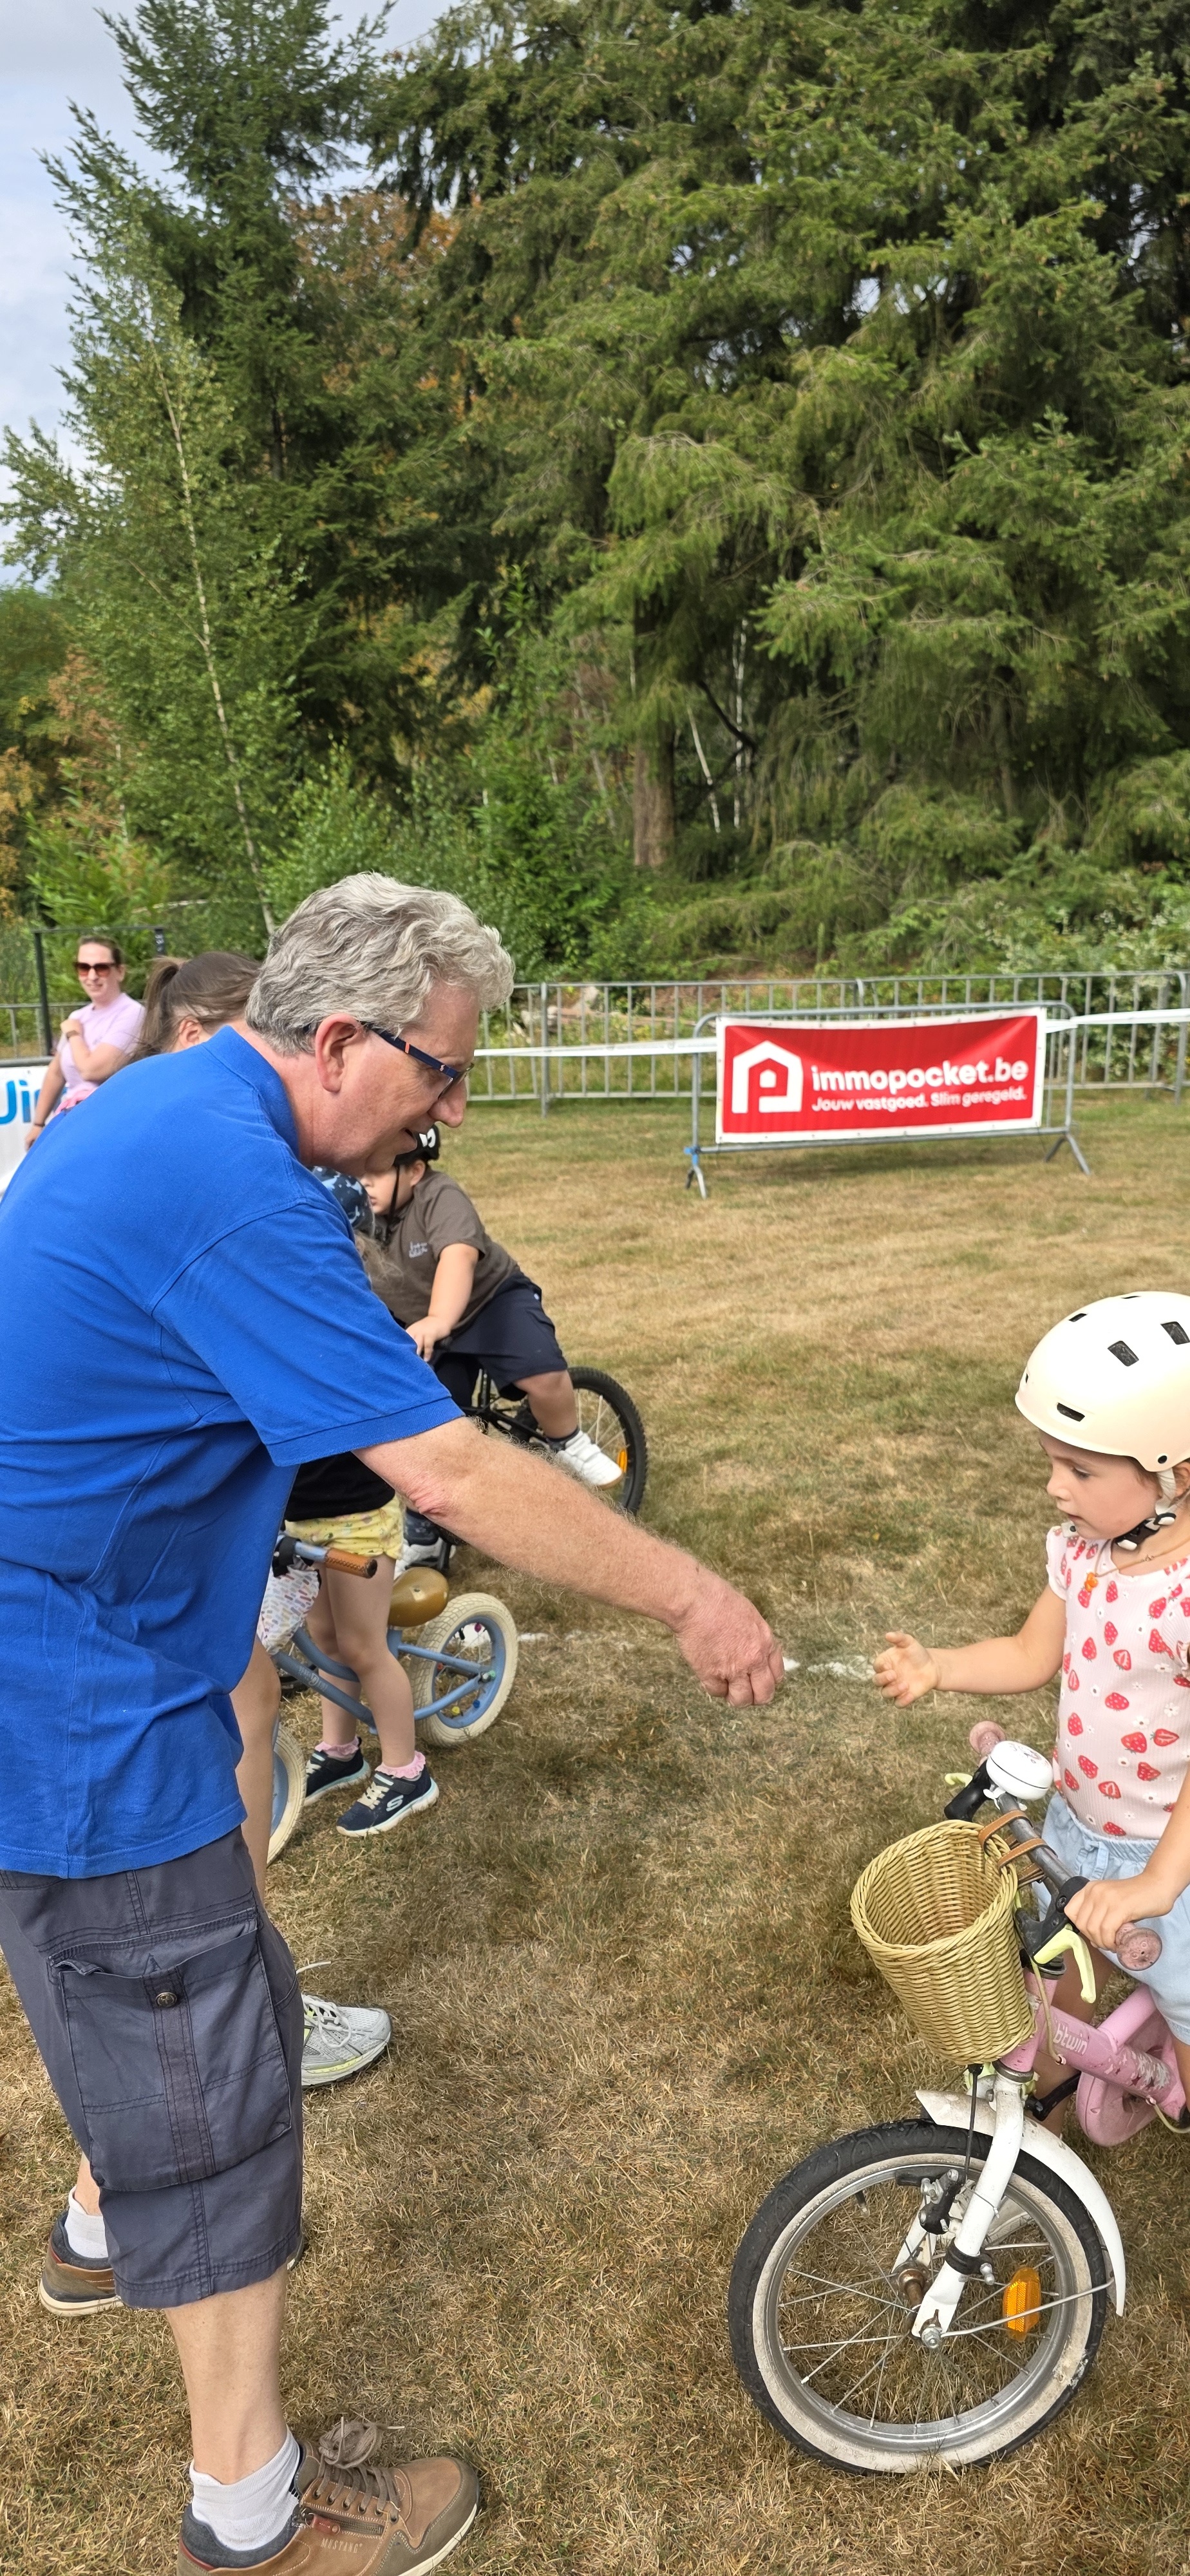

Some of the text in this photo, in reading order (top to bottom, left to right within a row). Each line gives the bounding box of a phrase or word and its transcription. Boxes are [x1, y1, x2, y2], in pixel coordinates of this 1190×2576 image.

[811, 1056, 1028, 1095] immopocket.be
[811, 1085, 1028, 1112] Jouw vastgoed. Slim geregeld.
